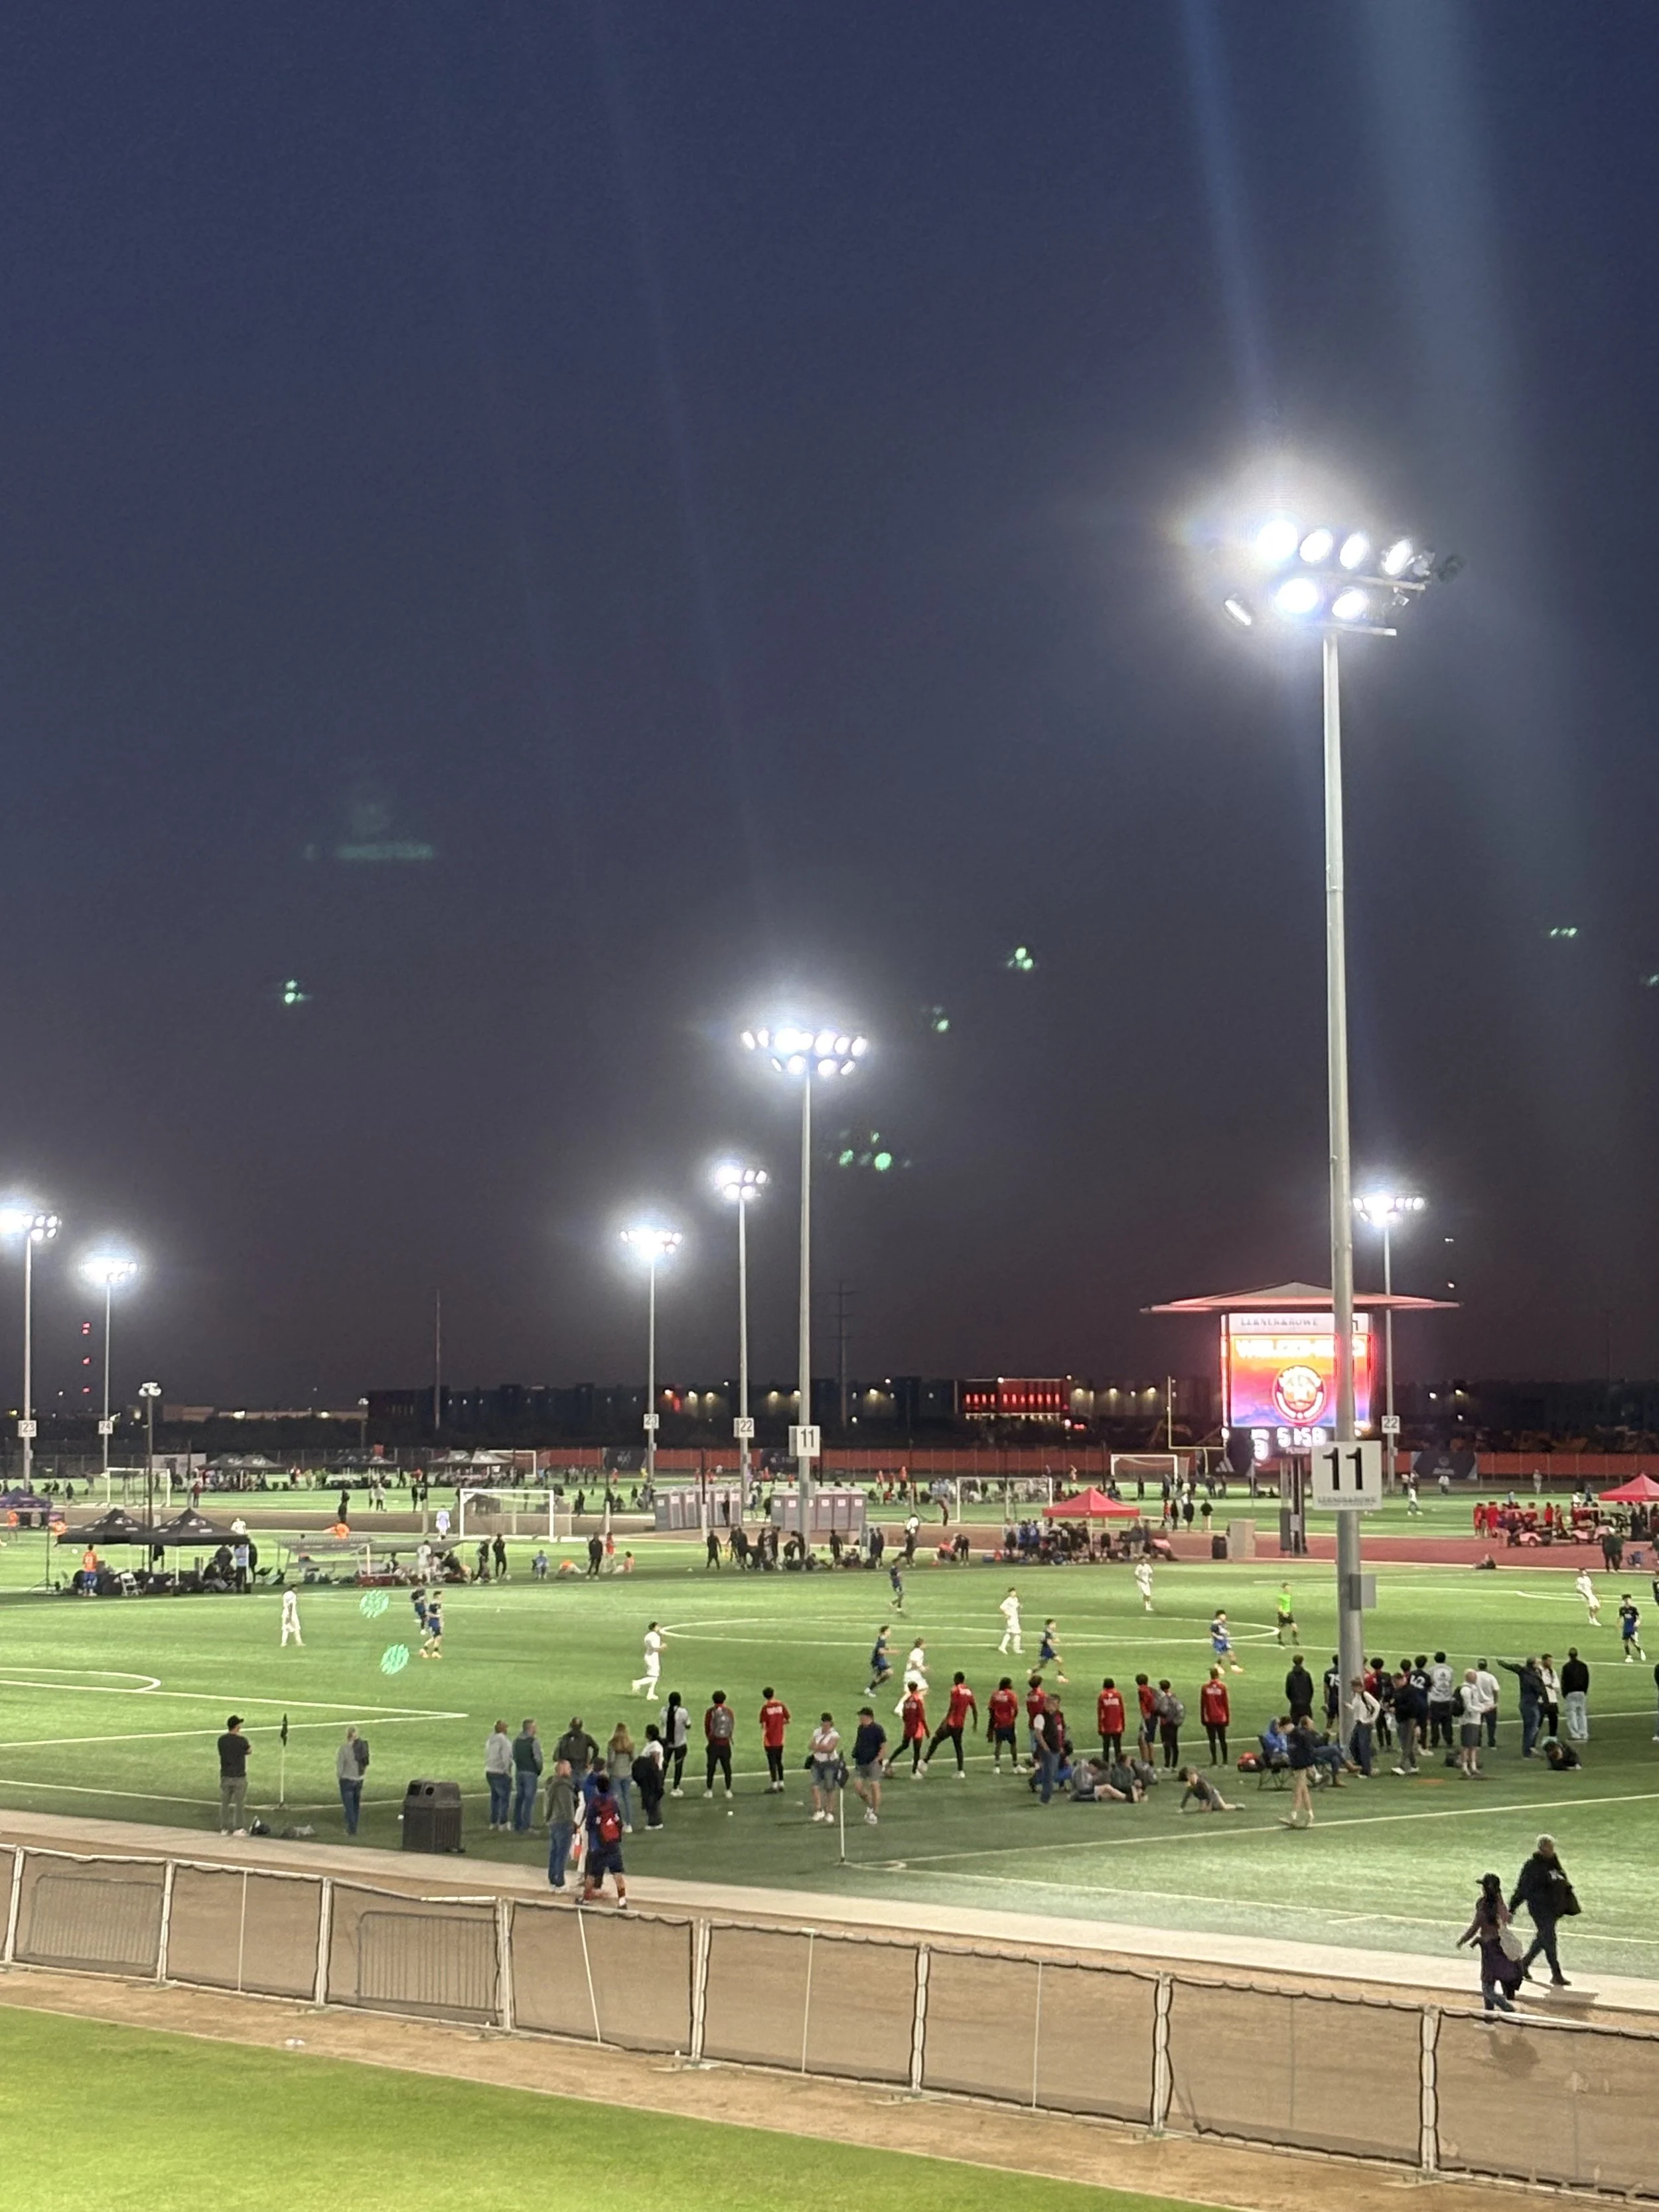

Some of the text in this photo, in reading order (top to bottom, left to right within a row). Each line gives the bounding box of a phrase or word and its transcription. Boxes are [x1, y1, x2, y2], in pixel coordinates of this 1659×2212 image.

[23, 1422, 35, 1432] 23
[741, 1420, 753, 1432] 22
[1384, 1417, 1398, 1429] 22
[800, 1428, 814, 1448] 11
[1323, 1447, 1363, 1491] 11
